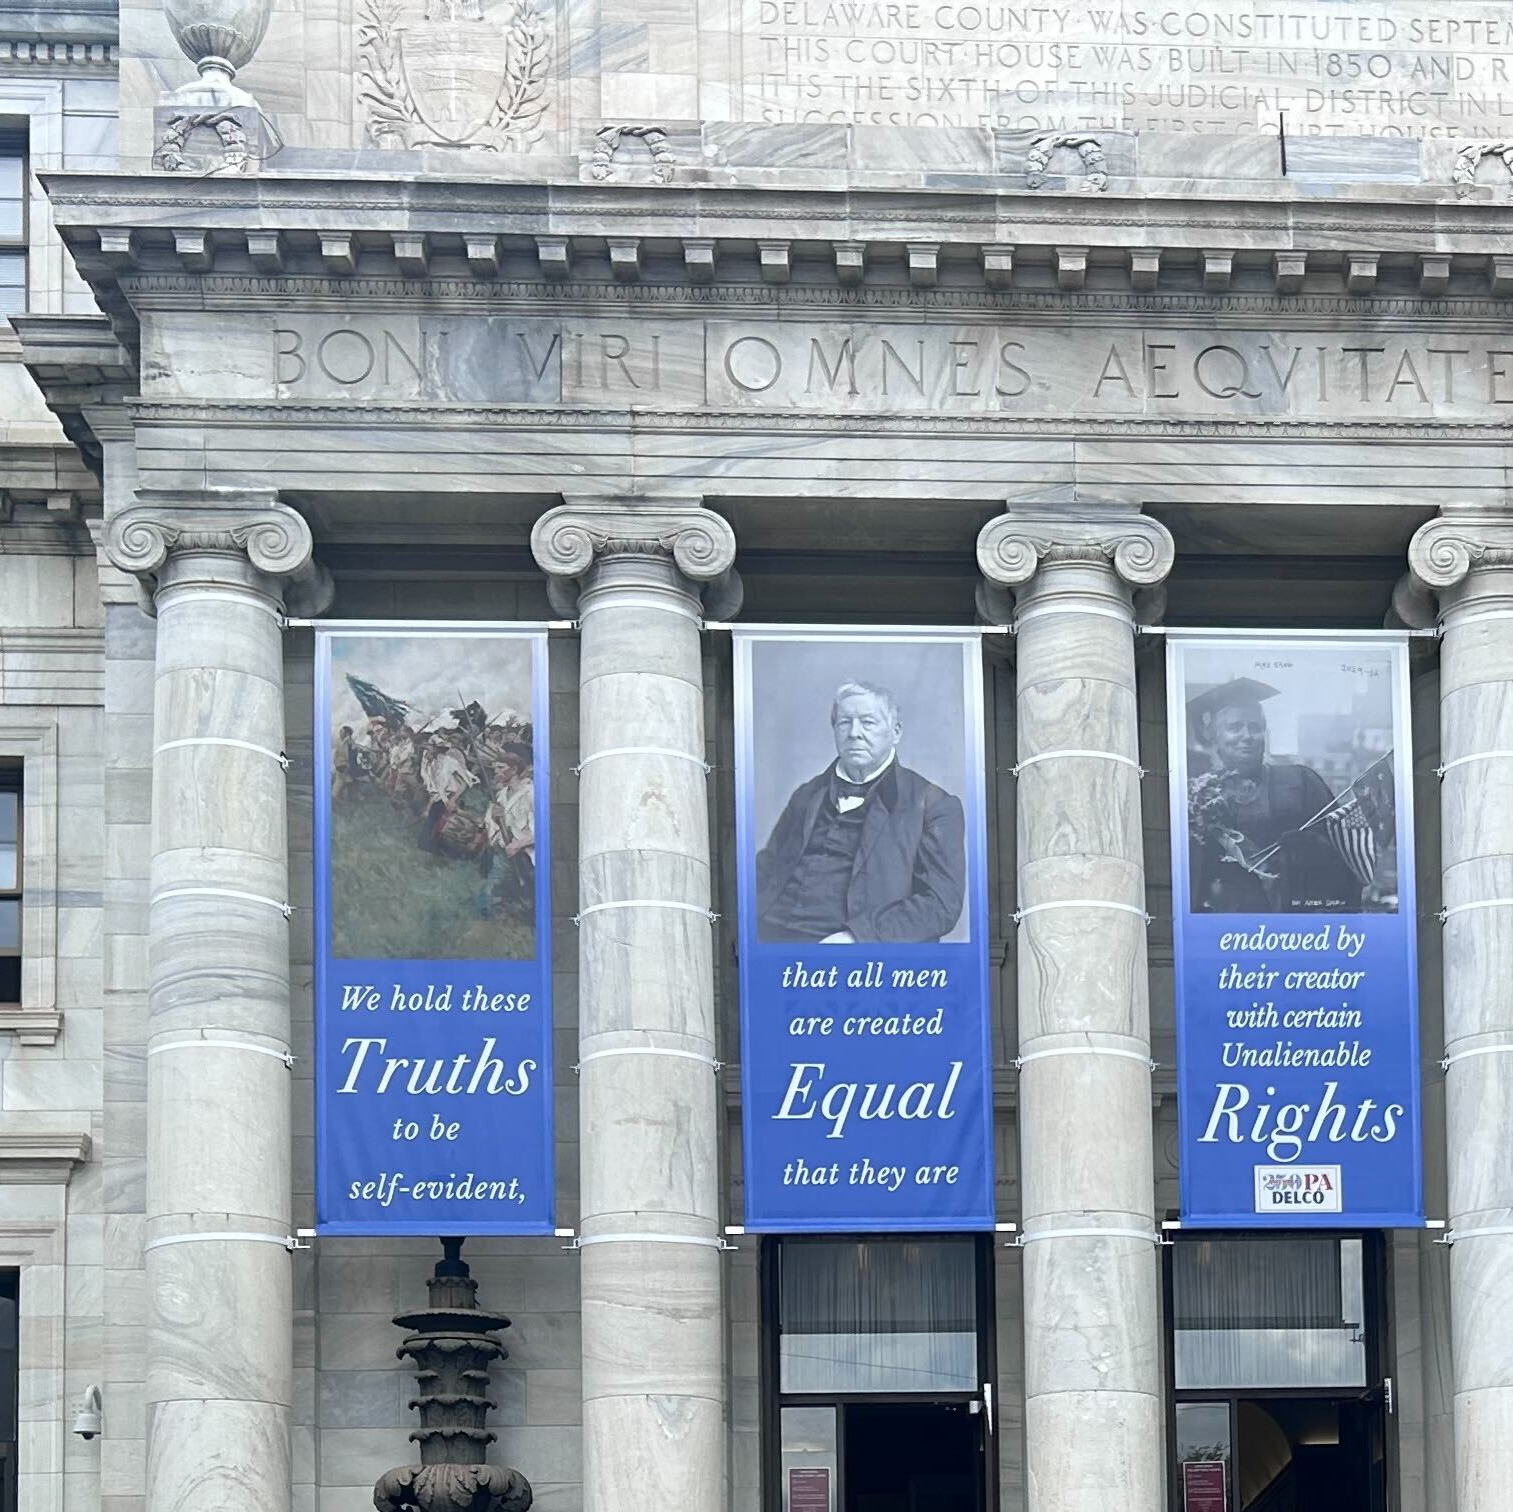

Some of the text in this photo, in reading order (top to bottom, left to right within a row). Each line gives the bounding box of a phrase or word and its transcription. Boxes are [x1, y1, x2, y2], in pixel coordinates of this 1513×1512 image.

[760, 1, 920, 30] DELAWARE
[935, 6, 1070, 33] COUNTY
[1088, 9, 1153, 36] WAS
[1162, 11, 1397, 43] CONSTITUTED
[759, 36, 831, 64] THIS
[845, 38, 957, 68] COURT
[975, 43, 1081, 71] HOUSE
[1092, 46, 1151, 72] WAS
[1168, 47, 1250, 74] BUILT
[1266, 50, 1297, 75] IN
[1315, 53, 1392, 79] 1850
[1411, 55, 1475, 82] AND
[760, 73, 785, 97] IT
[797, 74, 822, 98] IS
[833, 76, 893, 100] THE
[906, 77, 1000, 102] SIXTH
[1015, 80, 1058, 104] OF
[1069, 81, 1137, 106] THIS
[1150, 84, 1290, 112] JUDICIAL
[1306, 88, 1448, 116] DISTRICT
[1459, 92, 1487, 117] IN
[272, 329, 449, 389] BONI
[517, 333, 661, 391] VIRI
[725, 335, 1031, 397] OMNES
[1220, 925, 1365, 957] endowed by
[782, 961, 948, 988] that all men
[1218, 964, 1364, 990] their creator
[341, 984, 531, 1012] We hold these
[789, 1008, 944, 1036] are created
[1226, 1002, 1362, 1028] with certain
[337, 1037, 537, 1096] Truths
[1222, 1041, 1371, 1068] Unalienable
[771, 1061, 963, 1139] Equal
[393, 1113, 460, 1141] to be
[1197, 1081, 1404, 1162] Rights
[349, 1173, 526, 1206] self-evident,
[783, 1159, 959, 1191] that they are
[1272, 1190, 1325, 1205] DELCO
